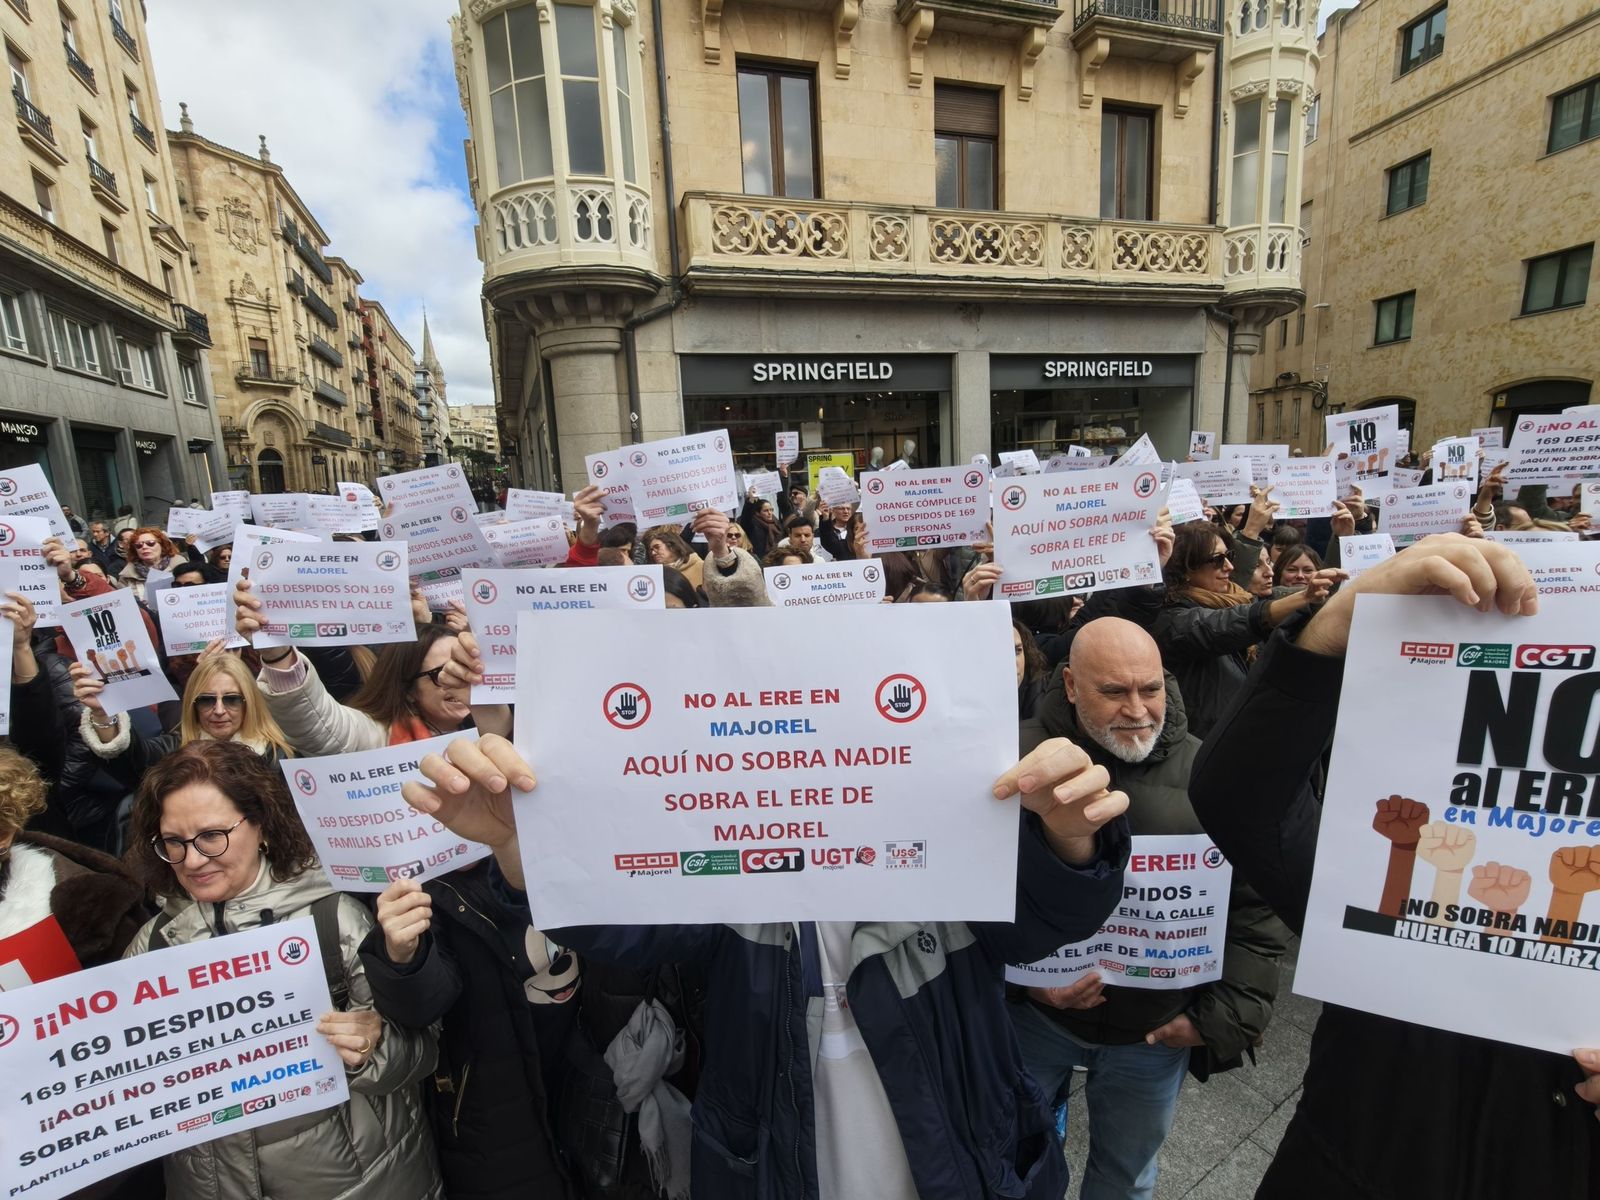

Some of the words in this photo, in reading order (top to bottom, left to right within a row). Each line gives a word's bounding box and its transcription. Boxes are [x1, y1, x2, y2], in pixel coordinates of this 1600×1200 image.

[753, 362, 893, 382] SPRINGFIELD
[1045, 361, 1153, 378] SPRINGFIELD
[1, 422, 38, 436] MANGO
[1350, 422, 1376, 443] NO
[1537, 422, 1572, 433] ¡¡NO
[1576, 421, 1598, 429] AL
[135, 440, 156, 450] MANGO
[1362, 441, 1377, 451] ERE
[1536, 437, 1560, 445] 169
[808, 455, 832, 463] SPRING
[1448, 445, 1465, 457] NO
[668, 456, 702, 466] MAJOREL
[921, 478, 938, 486] ERE
[1043, 488, 1059, 497] NO
[1063, 486, 1077, 496] AL
[1081, 484, 1101, 493] ERE
[1105, 482, 1119, 491] EN
[646, 485, 687, 499] FAMILIAS
[904, 488, 943, 496] MAJOREL
[4, 499, 18, 508] AL
[875, 499, 914, 511] ORANGE
[916, 496, 964, 509] CÓMPLICE
[966, 496, 977, 504] DE
[1056, 499, 1106, 512] MAJOREL
[879, 514, 895, 523] LOS
[898, 512, 942, 522] DESPIDOS
[944, 510, 957, 518] DE
[959, 508, 976, 516] 169
[1011, 520, 1045, 536] AQUÍ
[1047, 519, 1067, 532] NO
[1069, 516, 1108, 529] SOBRA
[1112, 509, 1147, 523] NADIE
[410, 526, 439, 537] MAJOREL
[904, 522, 951, 534] PERSONAS
[1030, 540, 1069, 555] SOBRA
[1073, 538, 1085, 549] EL
[1088, 535, 1109, 547] ERE
[1112, 531, 1126, 543] DE
[286, 555, 300, 563] NO
[303, 555, 316, 563] AL
[320, 555, 339, 563] ERE
[344, 555, 359, 563] EN
[1051, 554, 1105, 572] MAJOREL
[297, 567, 348, 575] MAJOREL
[260, 584, 280, 593] 169
[282, 584, 341, 593] DESPIDOS
[344, 584, 370, 594] SON
[374, 585, 395, 594] 169
[516, 586, 535, 594] NO
[539, 585, 556, 594] AL
[560, 584, 585, 593] ERE
[590, 583, 607, 592] EN
[811, 582, 846, 591] MAJOREL
[266, 600, 319, 609] FAMILIAS
[322, 600, 335, 609] EN
[341, 600, 355, 609] LA
[358, 601, 393, 610] CALLE
[532, 600, 595, 610] MAJOREL
[784, 595, 821, 606] ORANGE
[823, 590, 864, 605] CÓMPLICE
[866, 590, 876, 599] DE
[87, 610, 116, 637] NO
[485, 625, 510, 636] 169
[104, 632, 120, 646] ERE
[1521, 648, 1591, 667] CGT
[684, 693, 716, 709] NO
[724, 691, 752, 708] AL
[759, 690, 803, 706] ERE
[810, 688, 840, 704] EN
[710, 719, 817, 737] MAJOREL
[623, 750, 688, 777] AQUÍ
[696, 753, 734, 773] NO
[742, 749, 827, 771] SOBRA
[834, 746, 912, 767] NADIE
[329, 773, 346, 784] NO
[350, 771, 366, 781] AL
[369, 765, 395, 779] ERE
[399, 760, 419, 773] EN
[1450, 768, 1503, 808] al
[664, 791, 749, 812] SOBRA
[757, 790, 783, 808] EL
[791, 788, 834, 806] ERE
[842, 786, 874, 804] DE
[317, 816, 337, 828] 169
[339, 808, 405, 828] DESPIDOS
[1444, 806, 1476, 825] en
[1488, 806, 1600, 838] Majore
[328, 834, 382, 850] FAMILIAS
[384, 832, 404, 846] EN
[408, 826, 428, 841] LA
[714, 821, 829, 842] MAJOREL
[746, 852, 800, 870] CGT
[811, 848, 854, 866] UGT
[1131, 853, 1196, 872] ERE!!
[638, 868, 672, 877] Majorel
[1119, 907, 1140, 918] EN
[1145, 910, 1165, 920] LA
[1169, 906, 1215, 919] CALLE
[1399, 898, 1439, 918] ¡NO
[1444, 904, 1527, 933] SOBRA
[1098, 924, 1150, 938] SOBRA
[1155, 926, 1207, 940] NADIE!!
[1394, 920, 1481, 951] HUELGA
[1488, 935, 1516, 956] 10
[1065, 949, 1082, 958] EL
[1086, 943, 1113, 955] ERE
[1118, 945, 1139, 957] DE
[1145, 945, 1213, 959] MAJOREL
[1061, 962, 1095, 973] MAJOREL
[34, 990, 118, 1040] ¡¡NO
[133, 976, 179, 1005] AL
[188, 950, 272, 990] ERE!!
[49, 1035, 112, 1068] 169
[124, 990, 275, 1048] DESPIDOS
[21, 1081, 67, 1106] 169
[74, 1047, 182, 1091] FAMILIAS
[188, 1034, 216, 1054] EN
[221, 1027, 247, 1045] LA
[251, 1008, 313, 1036] CALLE
[40, 1090, 116, 1133] ¡¡AQUÍ
[123, 1081, 156, 1102] NO
[163, 1058, 232, 1089] SOBRA
[237, 1035, 310, 1066] NADIE!!
[19, 1125, 109, 1168] SOBRA
[115, 1114, 144, 1133] EL
[150, 1097, 192, 1121] ERE
[197, 1086, 224, 1105] DE
[230, 1058, 324, 1094] MAJOREL
[9, 1157, 90, 1197] PLANTILLA
[93, 1149, 111, 1162] DE
[114, 1128, 173, 1154] MAJOREL
